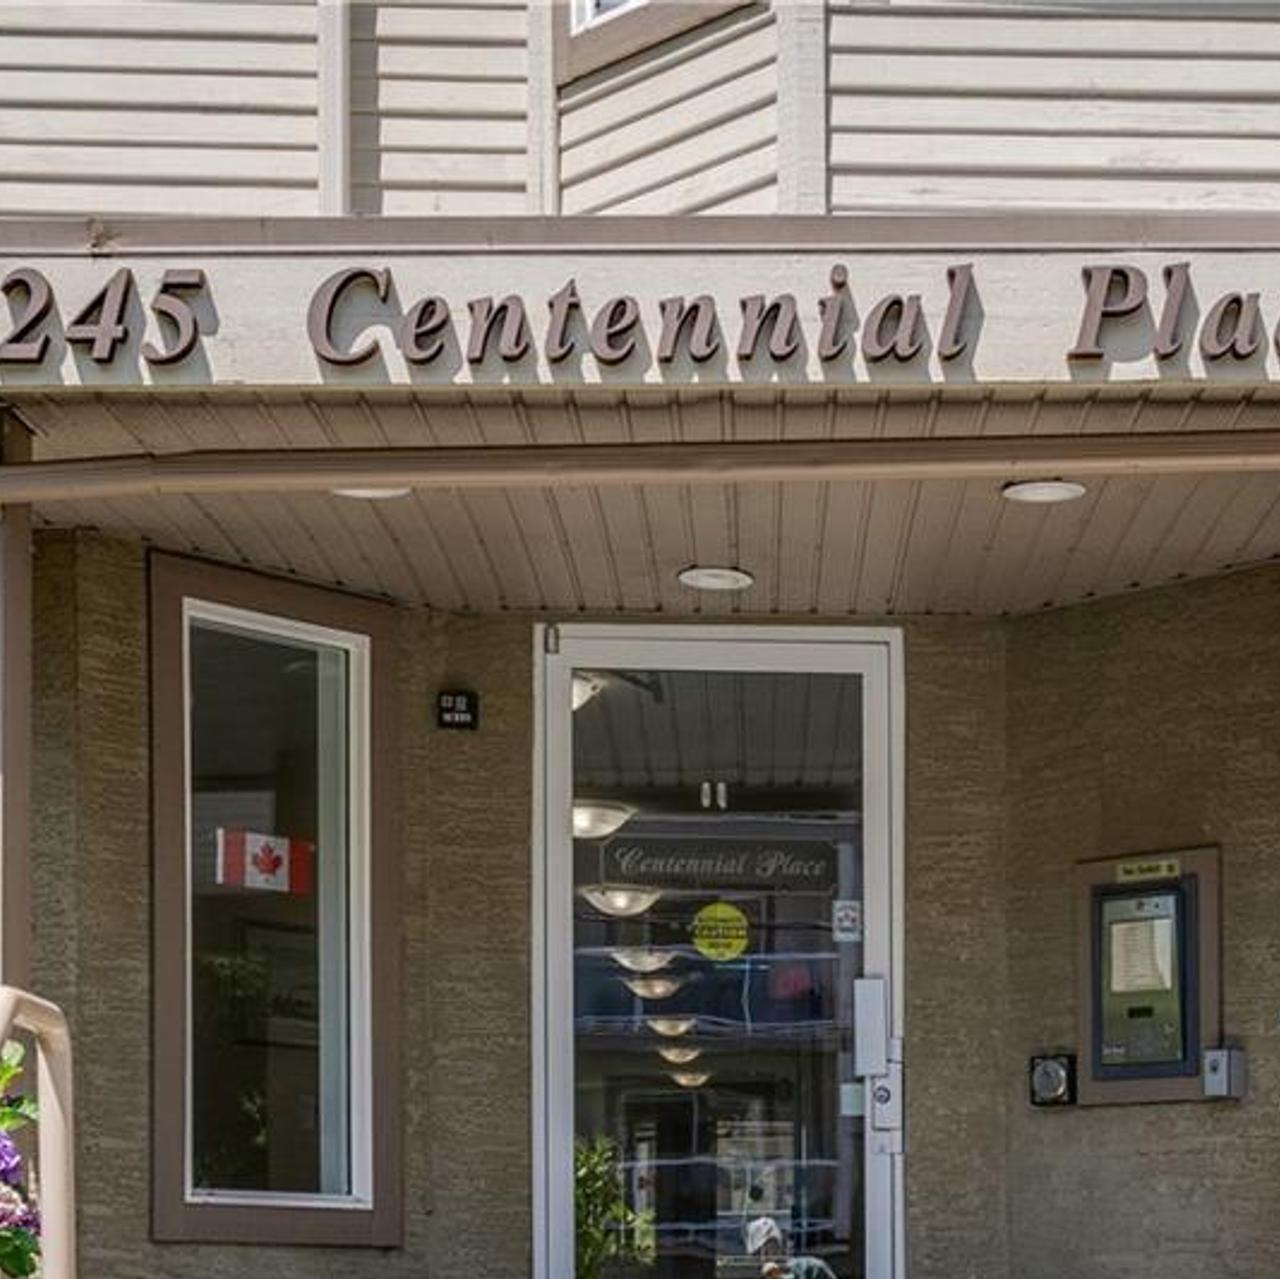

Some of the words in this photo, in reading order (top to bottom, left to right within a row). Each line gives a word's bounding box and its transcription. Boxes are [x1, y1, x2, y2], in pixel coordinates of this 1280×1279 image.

[306, 262, 978, 366] Centennial
[614, 846, 750, 876] Centennial
[756, 848, 826, 878] Place
